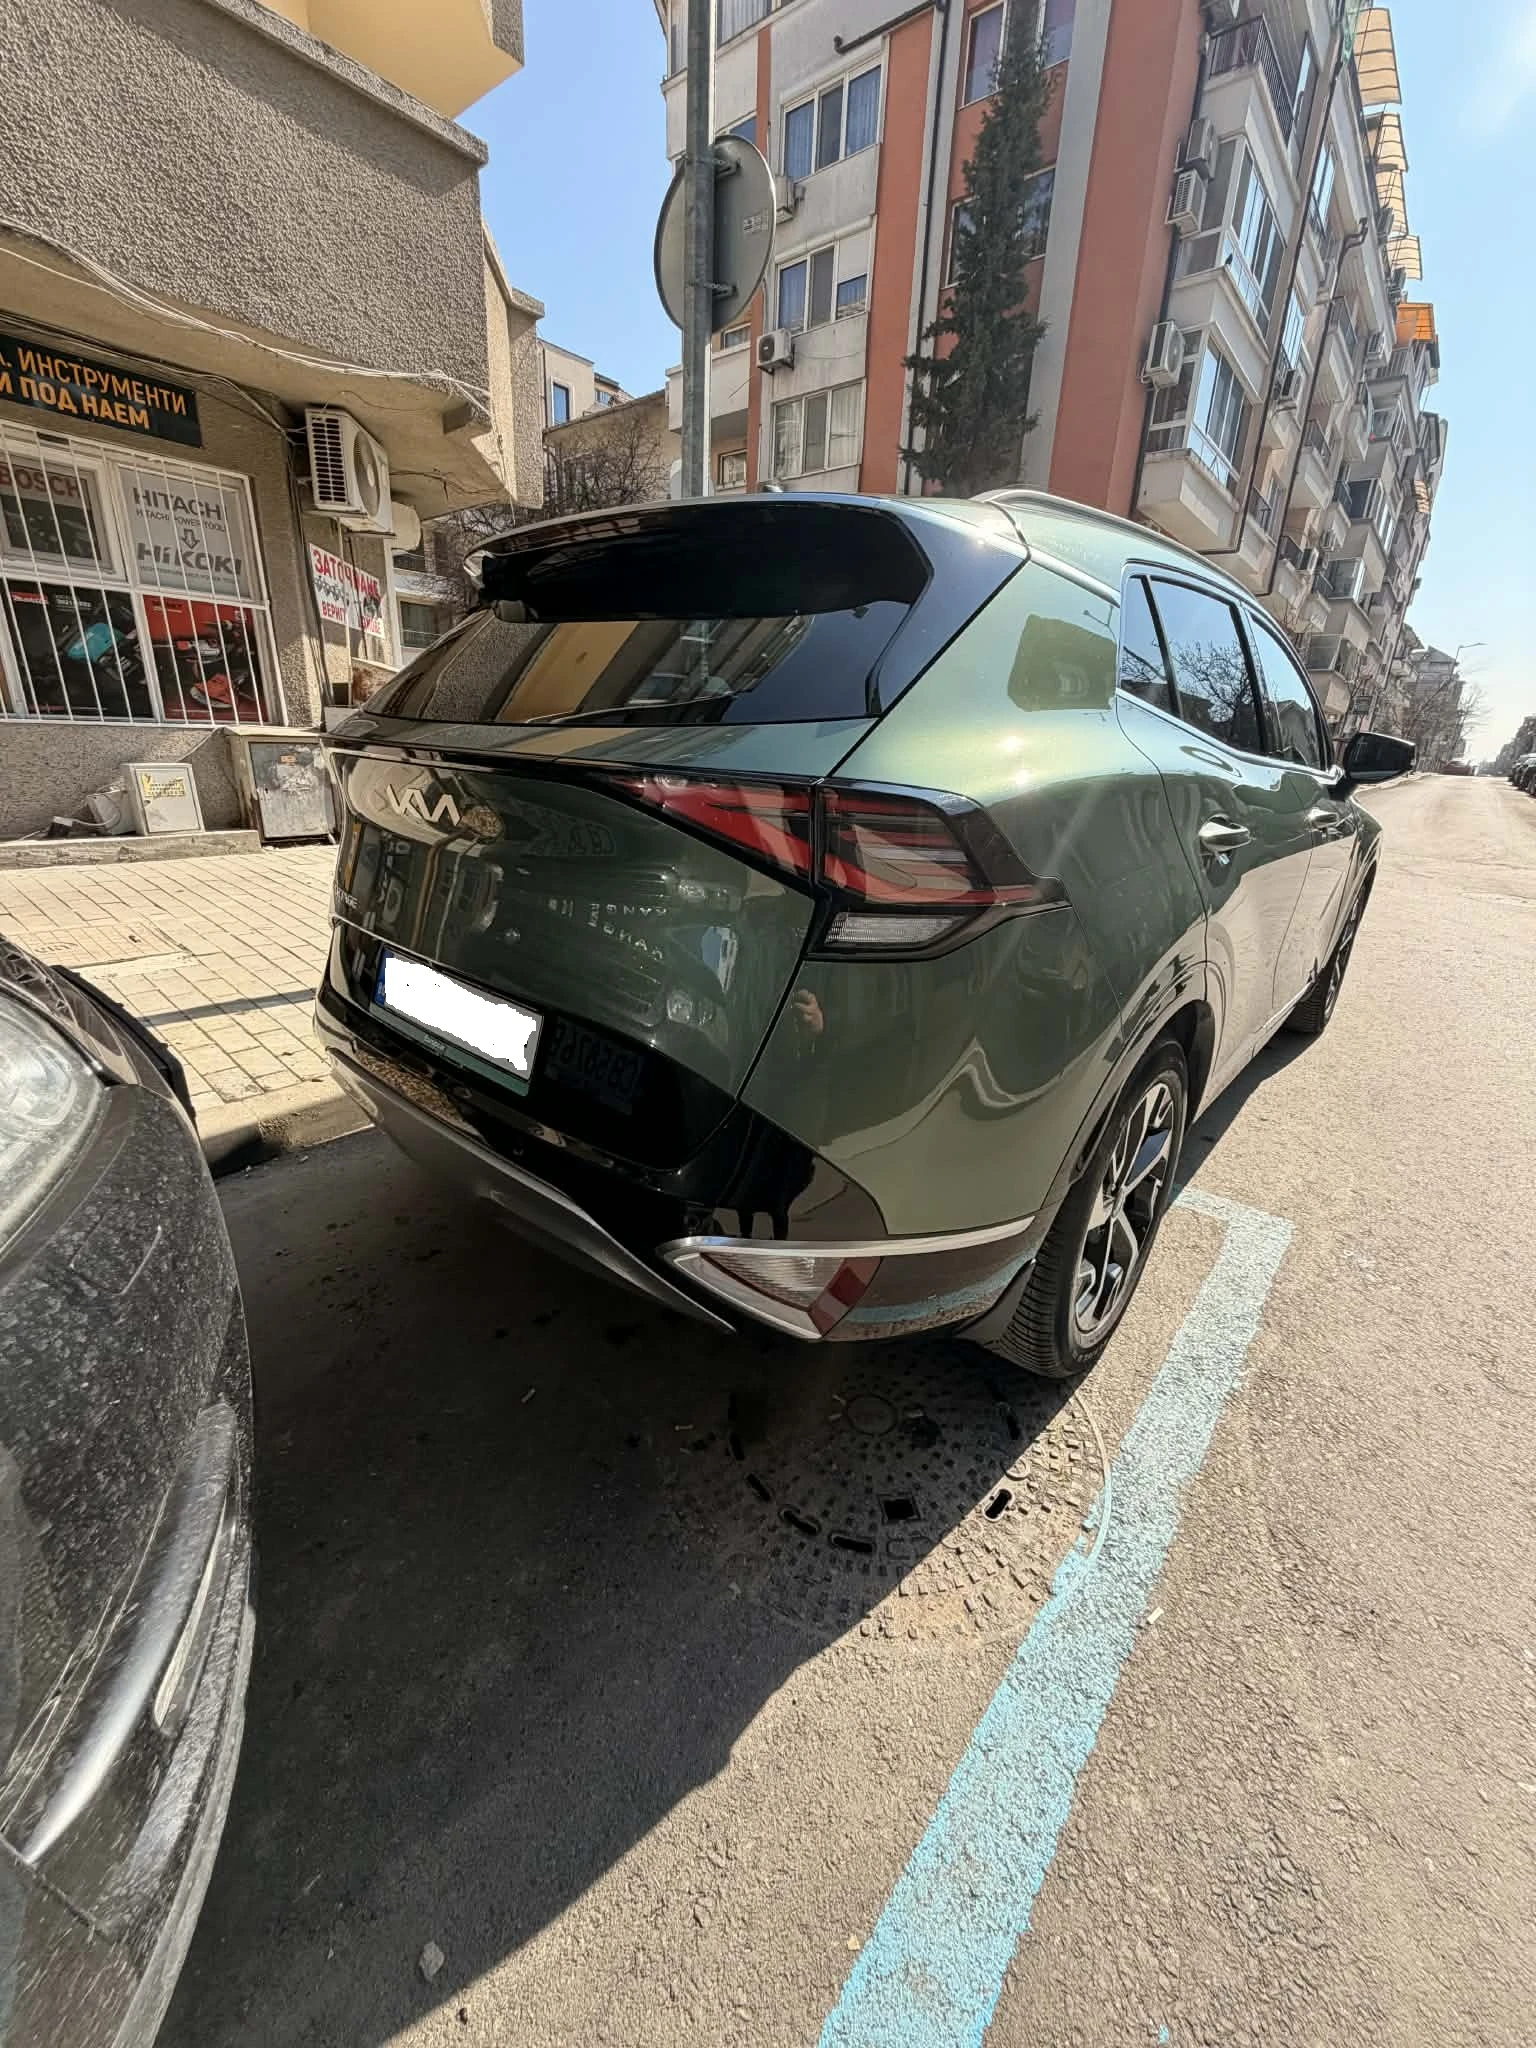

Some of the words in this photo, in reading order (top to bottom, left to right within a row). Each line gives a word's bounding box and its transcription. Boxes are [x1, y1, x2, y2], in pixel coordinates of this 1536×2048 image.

[17, 347, 187, 416] ИНСТРУМЕНТИ
[19, 376, 78, 414] ПОД
[81, 393, 150, 430] НАЕМ
[386, 783, 461, 827] KIA
